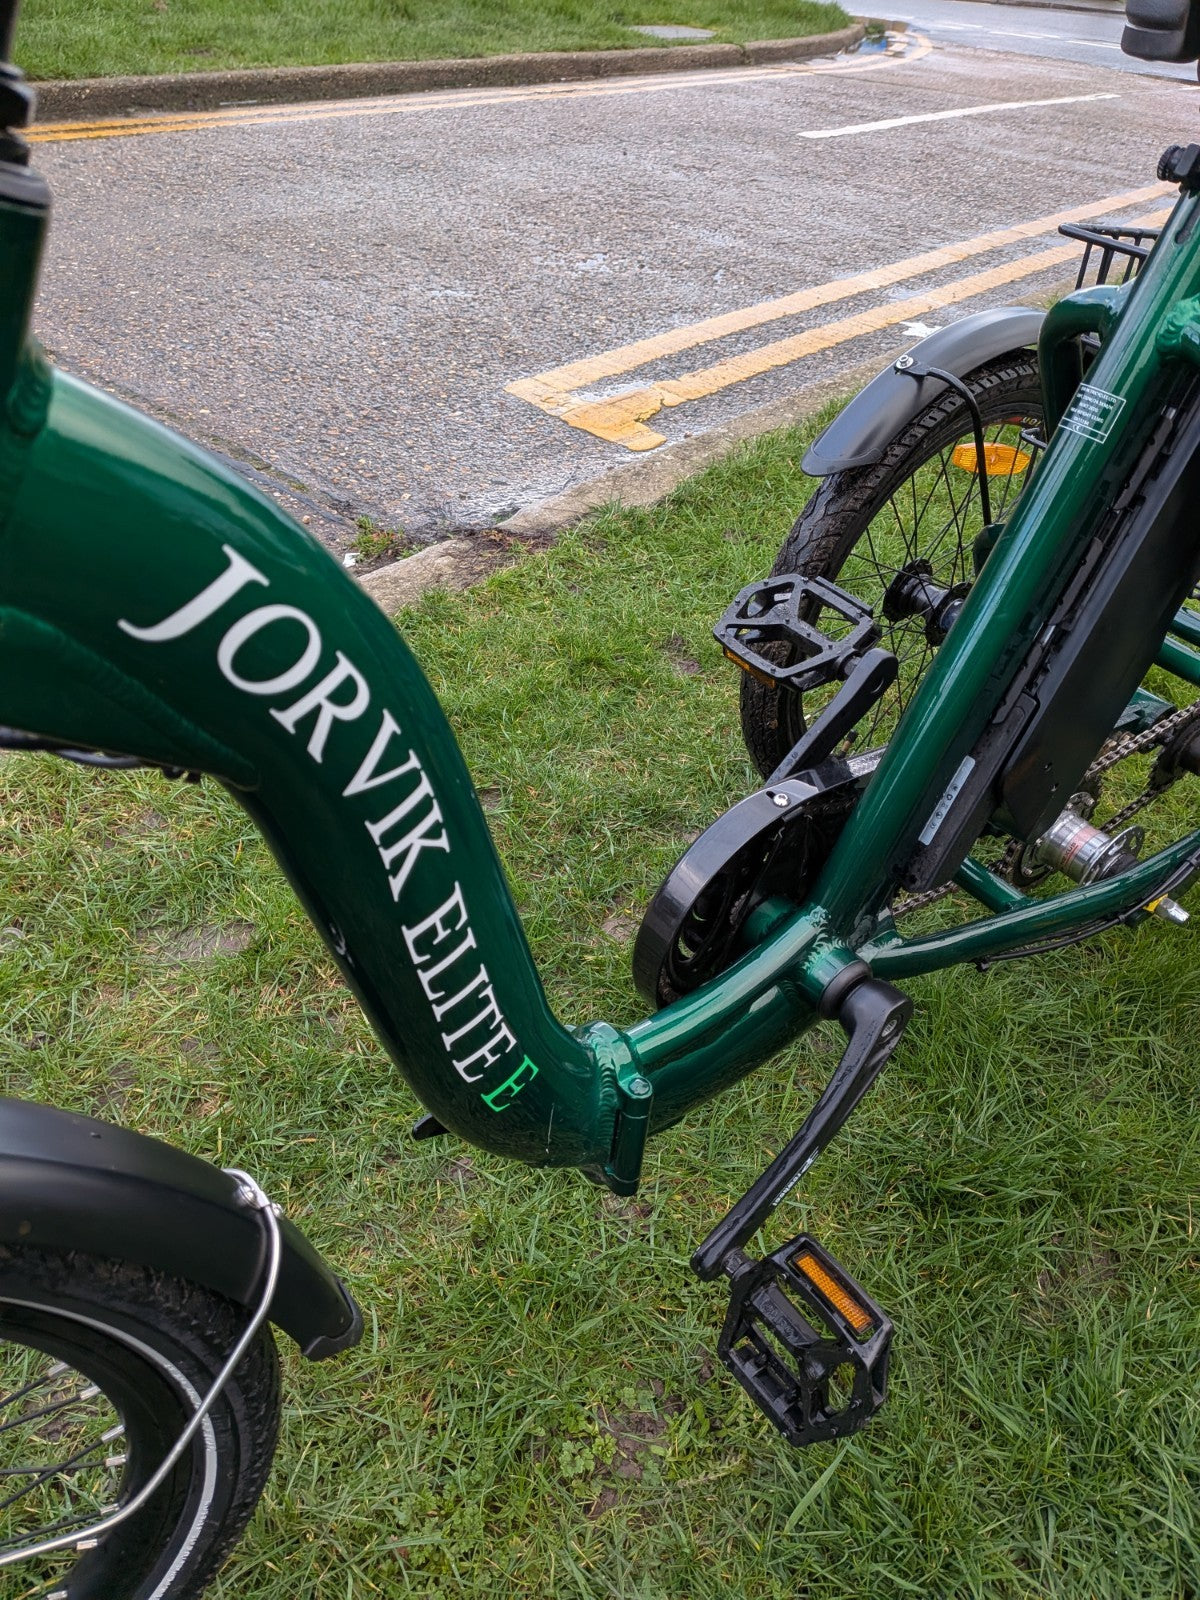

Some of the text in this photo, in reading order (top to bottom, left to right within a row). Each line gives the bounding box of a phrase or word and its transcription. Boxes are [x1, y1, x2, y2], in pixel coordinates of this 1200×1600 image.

[118, 544, 539, 1113] JORVIK ELITE E
